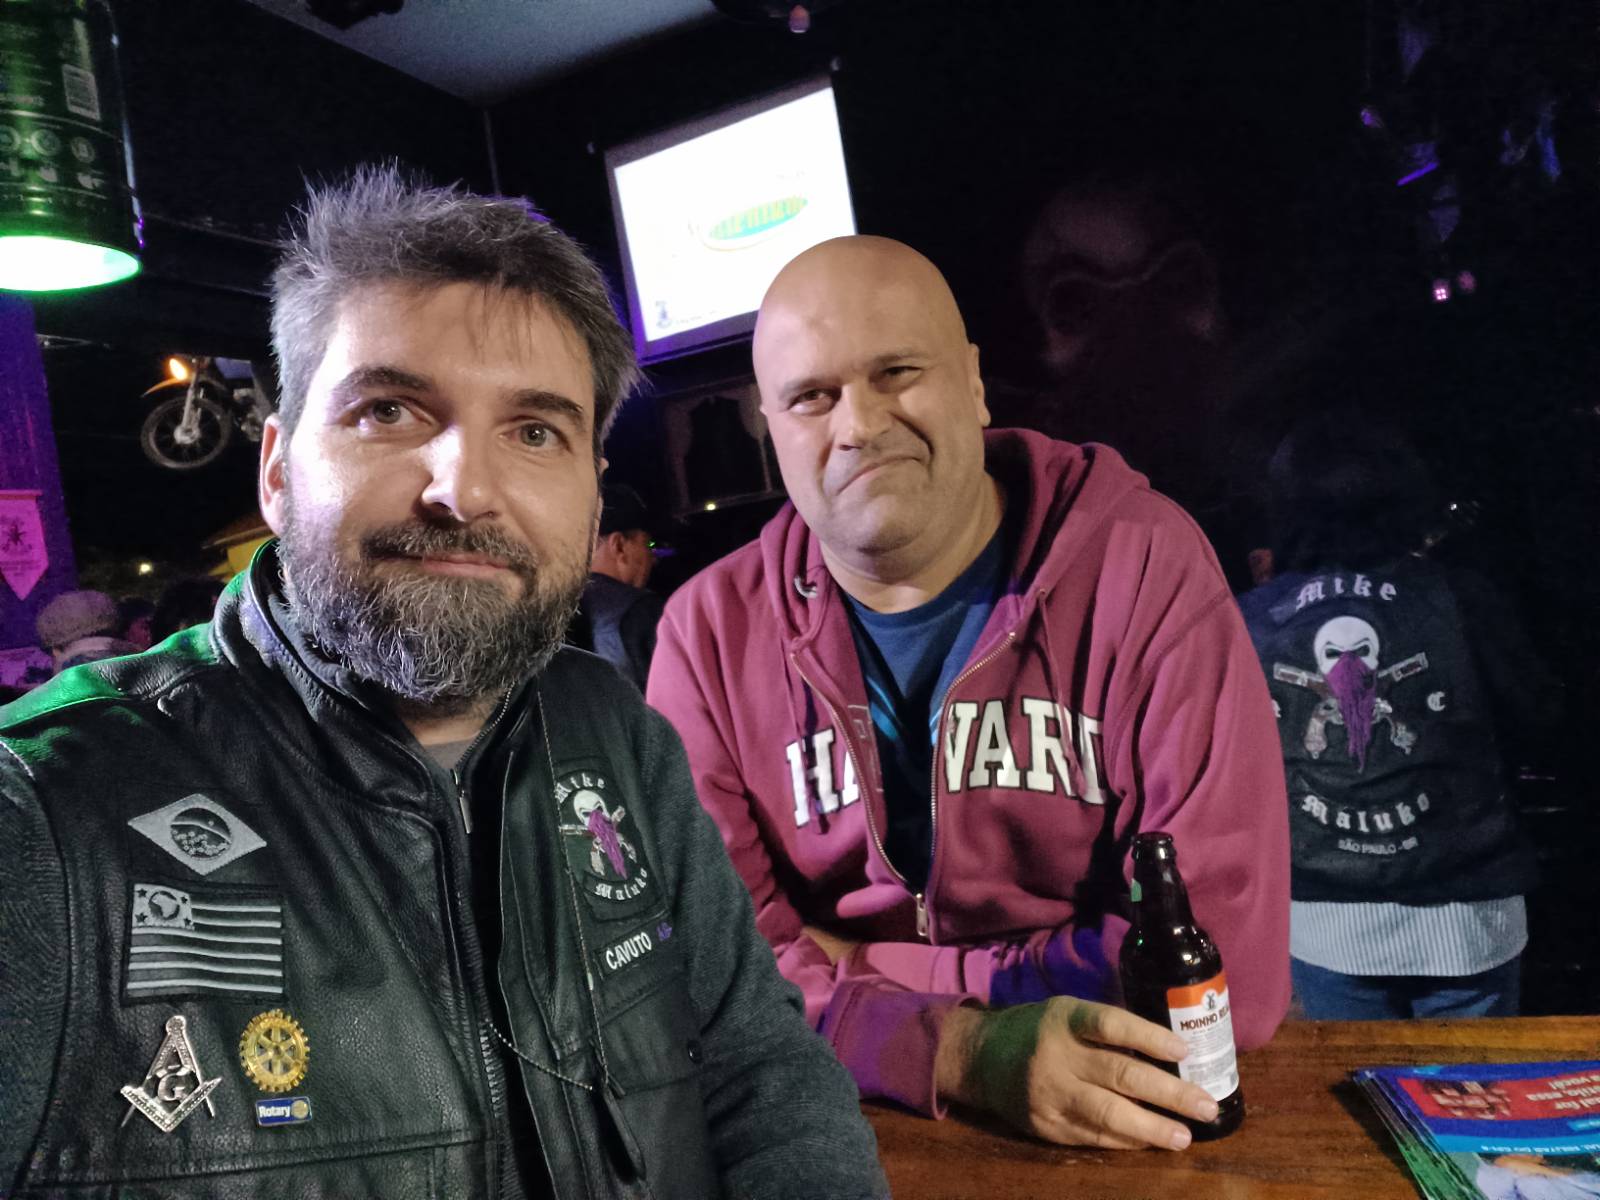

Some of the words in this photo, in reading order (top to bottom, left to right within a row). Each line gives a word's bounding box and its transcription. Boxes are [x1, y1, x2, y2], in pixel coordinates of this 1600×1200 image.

[1296, 573, 1397, 612] Mike
[1427, 691, 1446, 712] C
[555, 773, 605, 803] Mike
[1302, 793, 1430, 833] Maluko
[595, 867, 648, 901] Maluko
[605, 931, 652, 970] CAVUTO
[1180, 1013, 1217, 1030] MOINHO
[258, 1104, 290, 1119] Rotary
